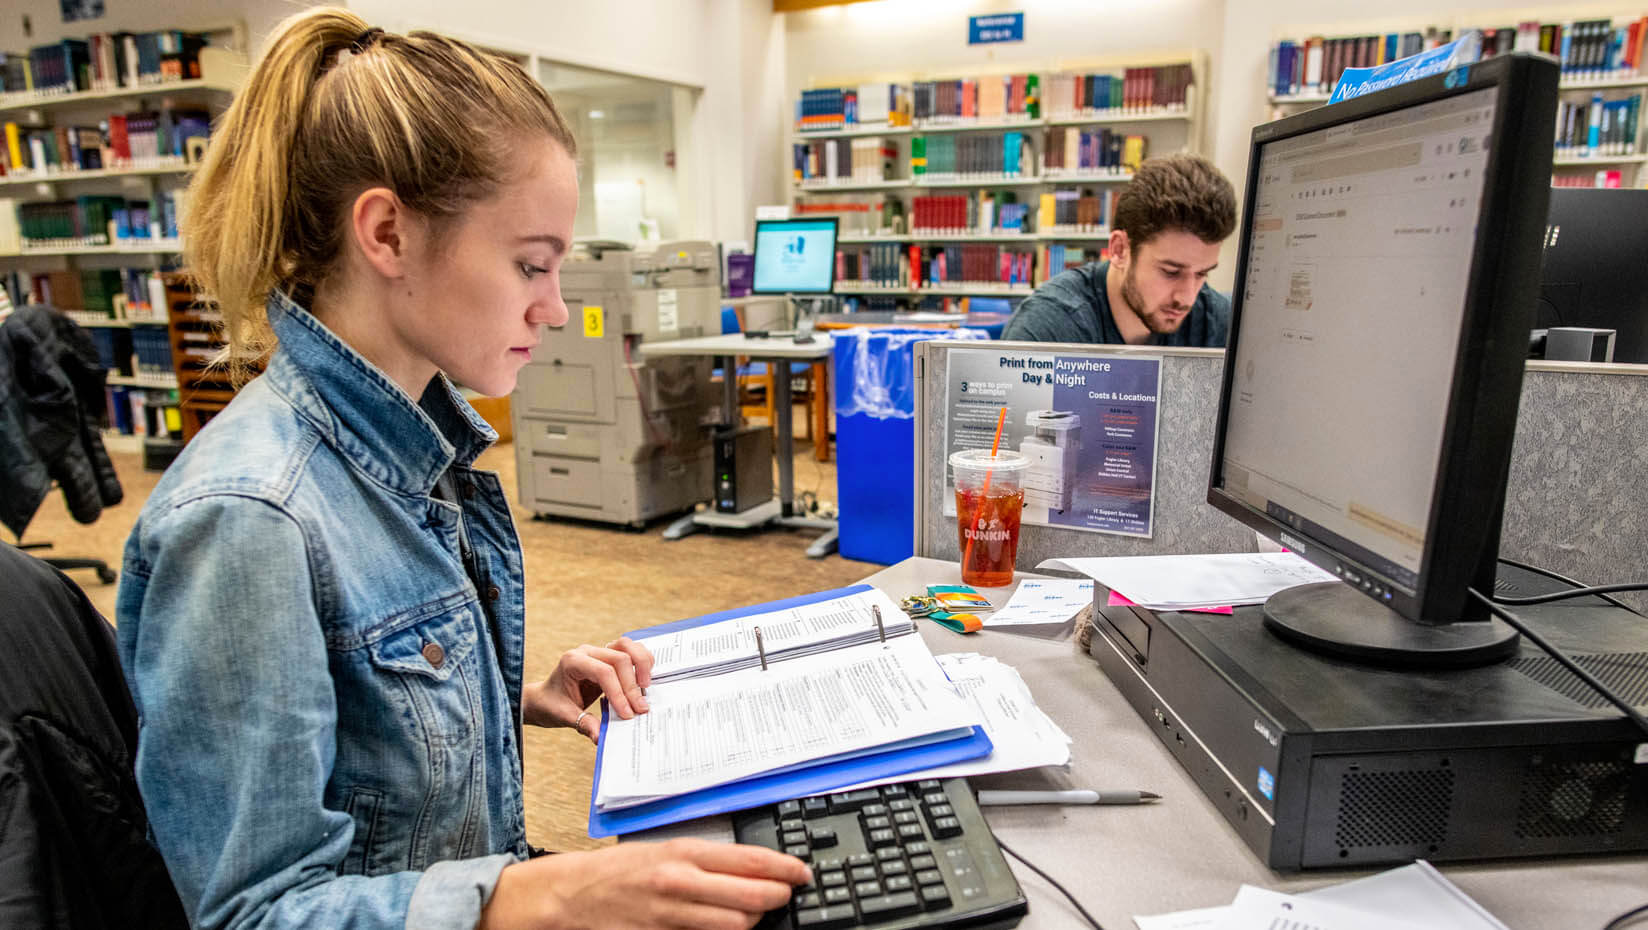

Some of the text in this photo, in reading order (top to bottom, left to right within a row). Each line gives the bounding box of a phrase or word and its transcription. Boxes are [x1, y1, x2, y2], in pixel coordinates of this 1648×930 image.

[1336, 82, 1356, 100] No
[587, 312, 599, 332] 3
[1000, 357, 1111, 373] Print from Anywhere
[960, 382, 968, 392] 3
[1022, 373, 1086, 387] Day & Night
[1088, 391, 1156, 402] Costs & Locations
[964, 528, 1010, 541] DUNKIN
